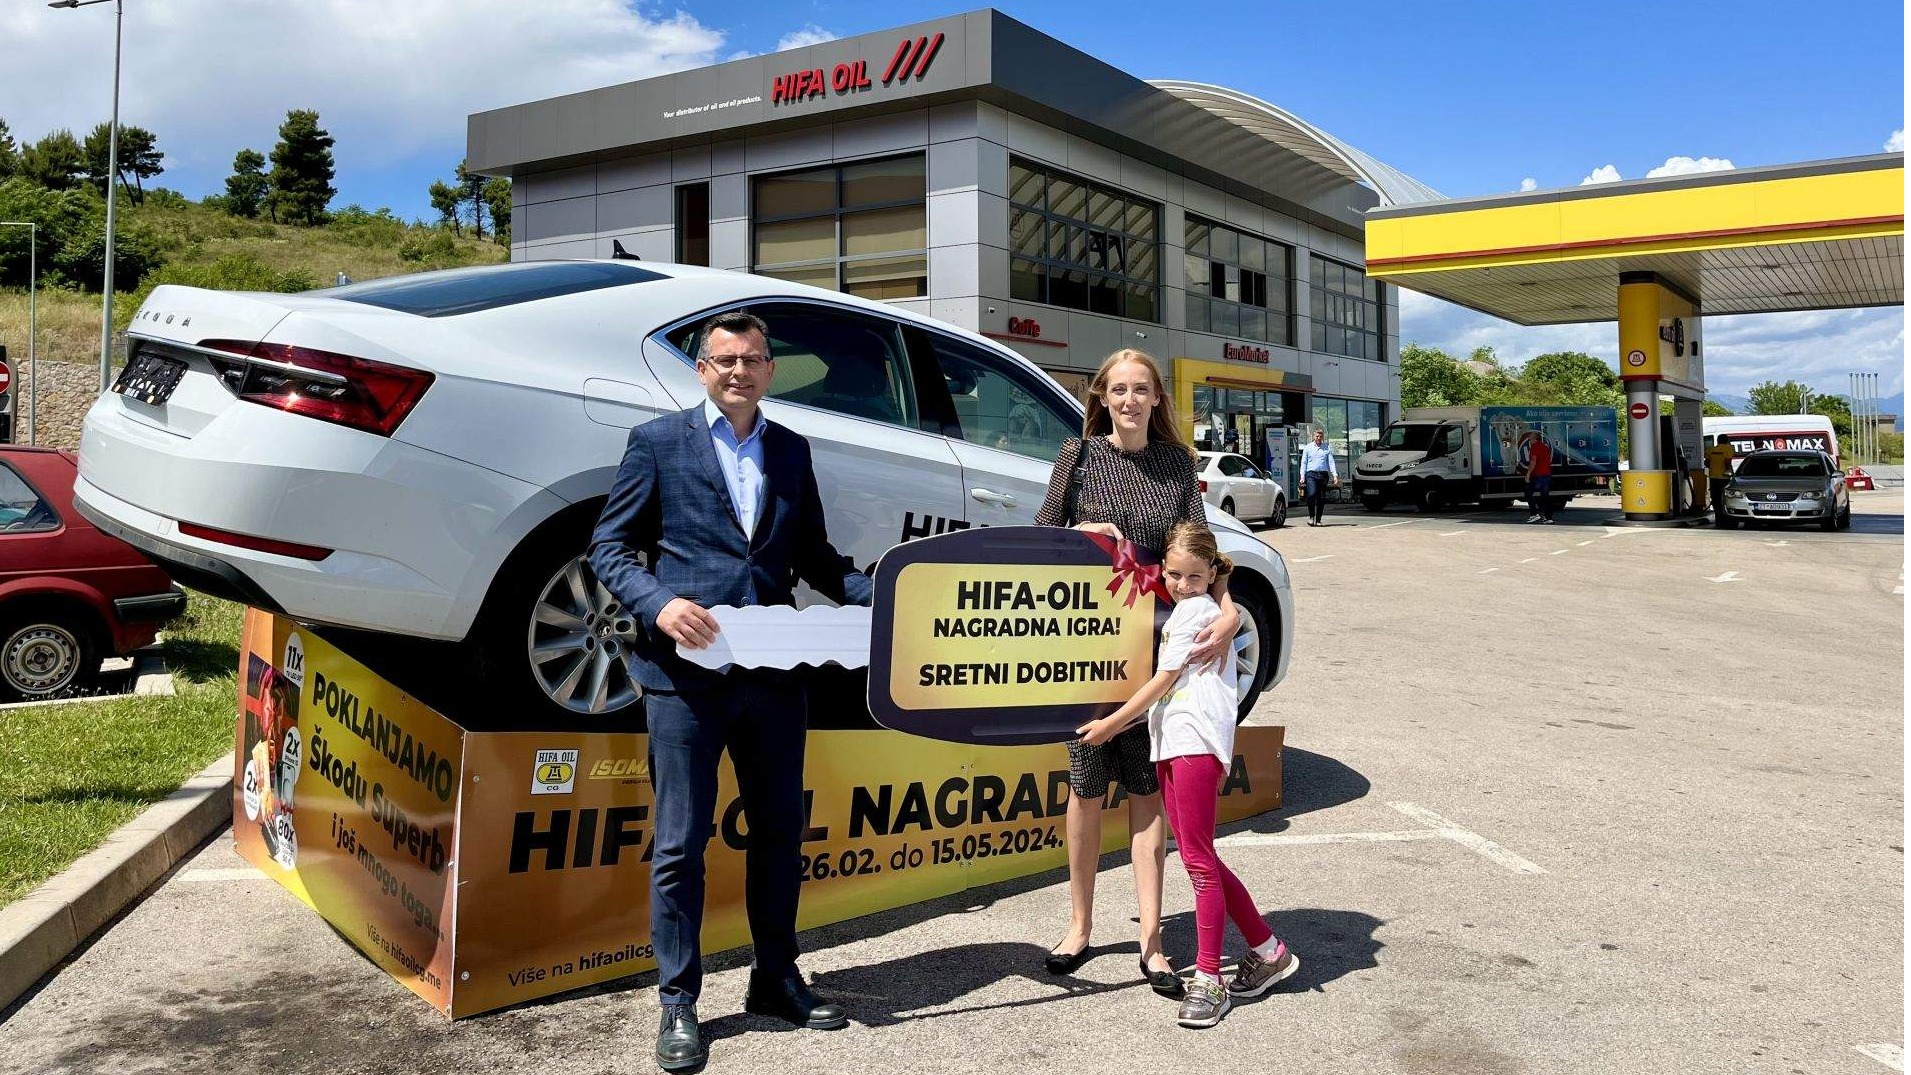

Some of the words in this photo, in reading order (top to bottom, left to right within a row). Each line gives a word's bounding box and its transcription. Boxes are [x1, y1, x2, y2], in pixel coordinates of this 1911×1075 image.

[772, 68, 825, 103] HIFA
[831, 60, 872, 92] OIL
[663, 111, 675, 119] Your
[676, 107, 703, 117] distributor
[719, 101, 729, 109] and
[957, 581, 1099, 610] HIFA-OIL
[933, 617, 1060, 638] NAGRADNA
[1067, 616, 1121, 637] IGRA!
[918, 662, 1009, 687] SRETNI
[1016, 659, 1129, 685] DOBITNIK
[313, 671, 453, 803] POKLANJAMO
[538, 751, 558, 763] HIFA
[561, 751, 576, 763] OIL
[309, 723, 367, 811] Škodu
[371, 782, 446, 877] Superb
[331, 812, 337, 838] i
[337, 817, 356, 854] još
[357, 843, 398, 896] mnogo
[801, 848, 881, 882] 26.02.
[890, 844, 923, 870] do
[931, 826, 1064, 865] 15.05.2024.
[366, 922, 380, 945] Više
[380, 936, 390, 953] na
[391, 942, 442, 991] hifaoilcg.me
[508, 967, 546, 987] Više
[551, 962, 573, 977] na
